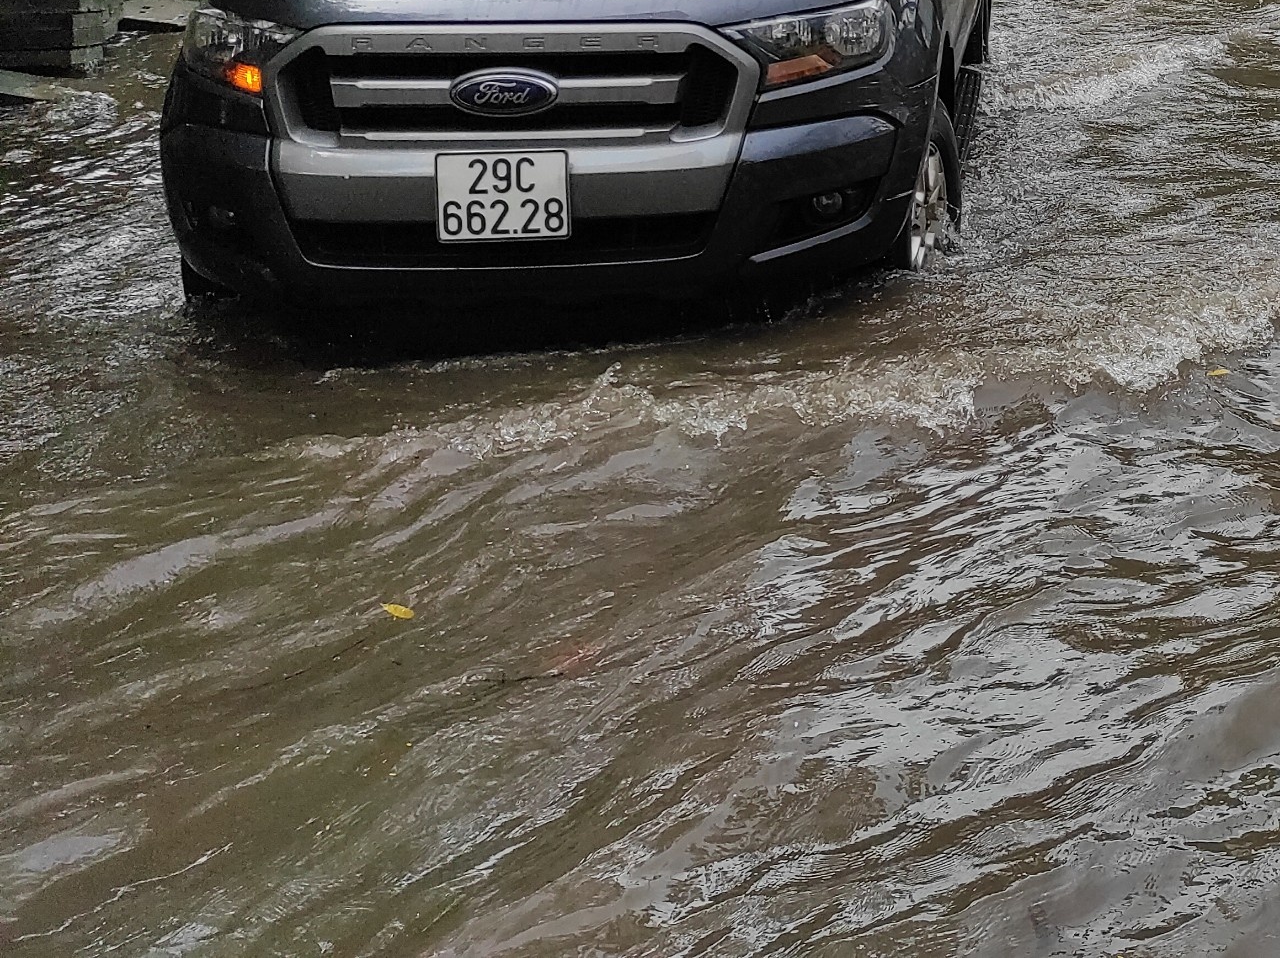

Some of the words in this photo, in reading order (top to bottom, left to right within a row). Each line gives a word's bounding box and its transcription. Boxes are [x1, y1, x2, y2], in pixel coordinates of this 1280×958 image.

[351, 36, 659, 50] RANGER
[474, 81, 532, 104] Ford
[468, 157, 535, 194] 29C
[443, 197, 564, 236] 662.28
